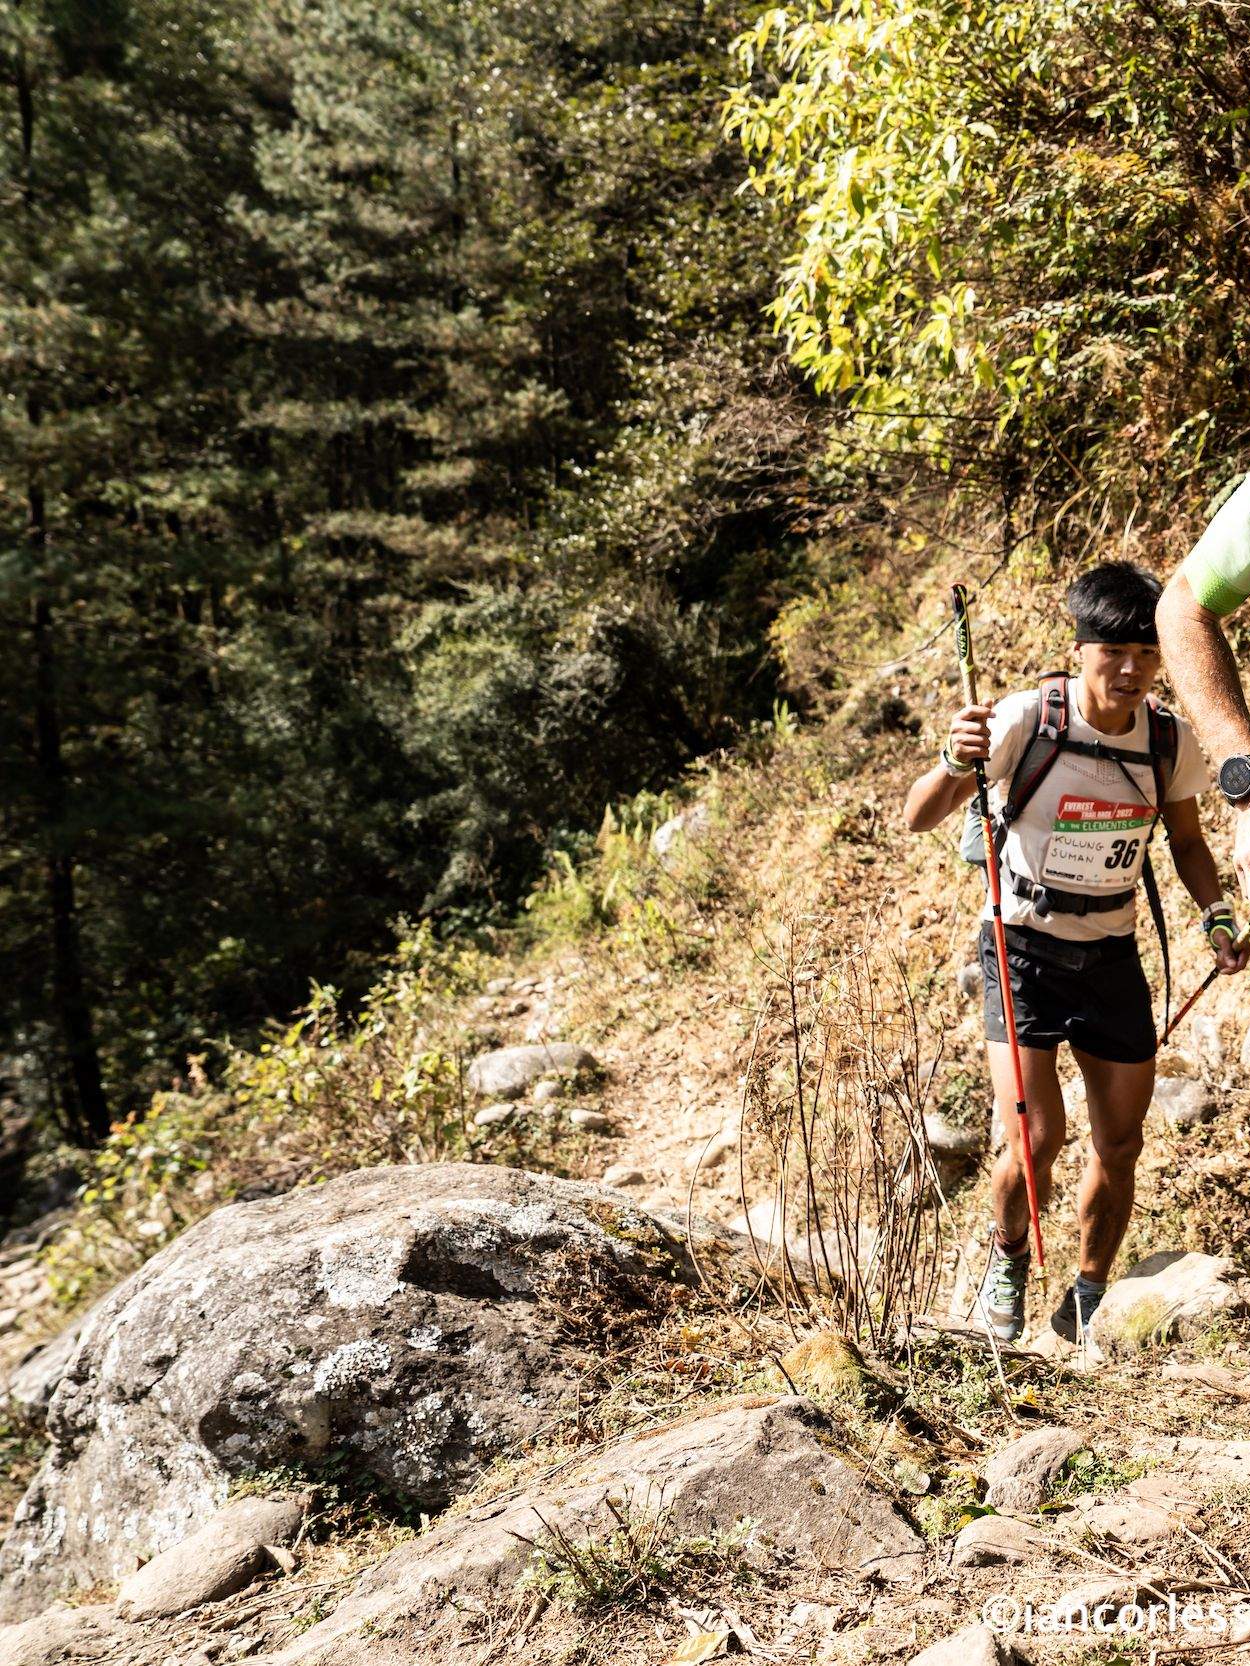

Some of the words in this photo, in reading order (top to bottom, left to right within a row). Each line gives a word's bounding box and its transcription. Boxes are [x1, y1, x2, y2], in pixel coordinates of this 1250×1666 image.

[1064, 801, 1095, 811] EVEREST
[1082, 820, 1127, 832] ELEMENTS
[1055, 835, 1105, 852] KULUNG
[1051, 847, 1094, 863] SUMAN
[1104, 838, 1140, 869] 36
